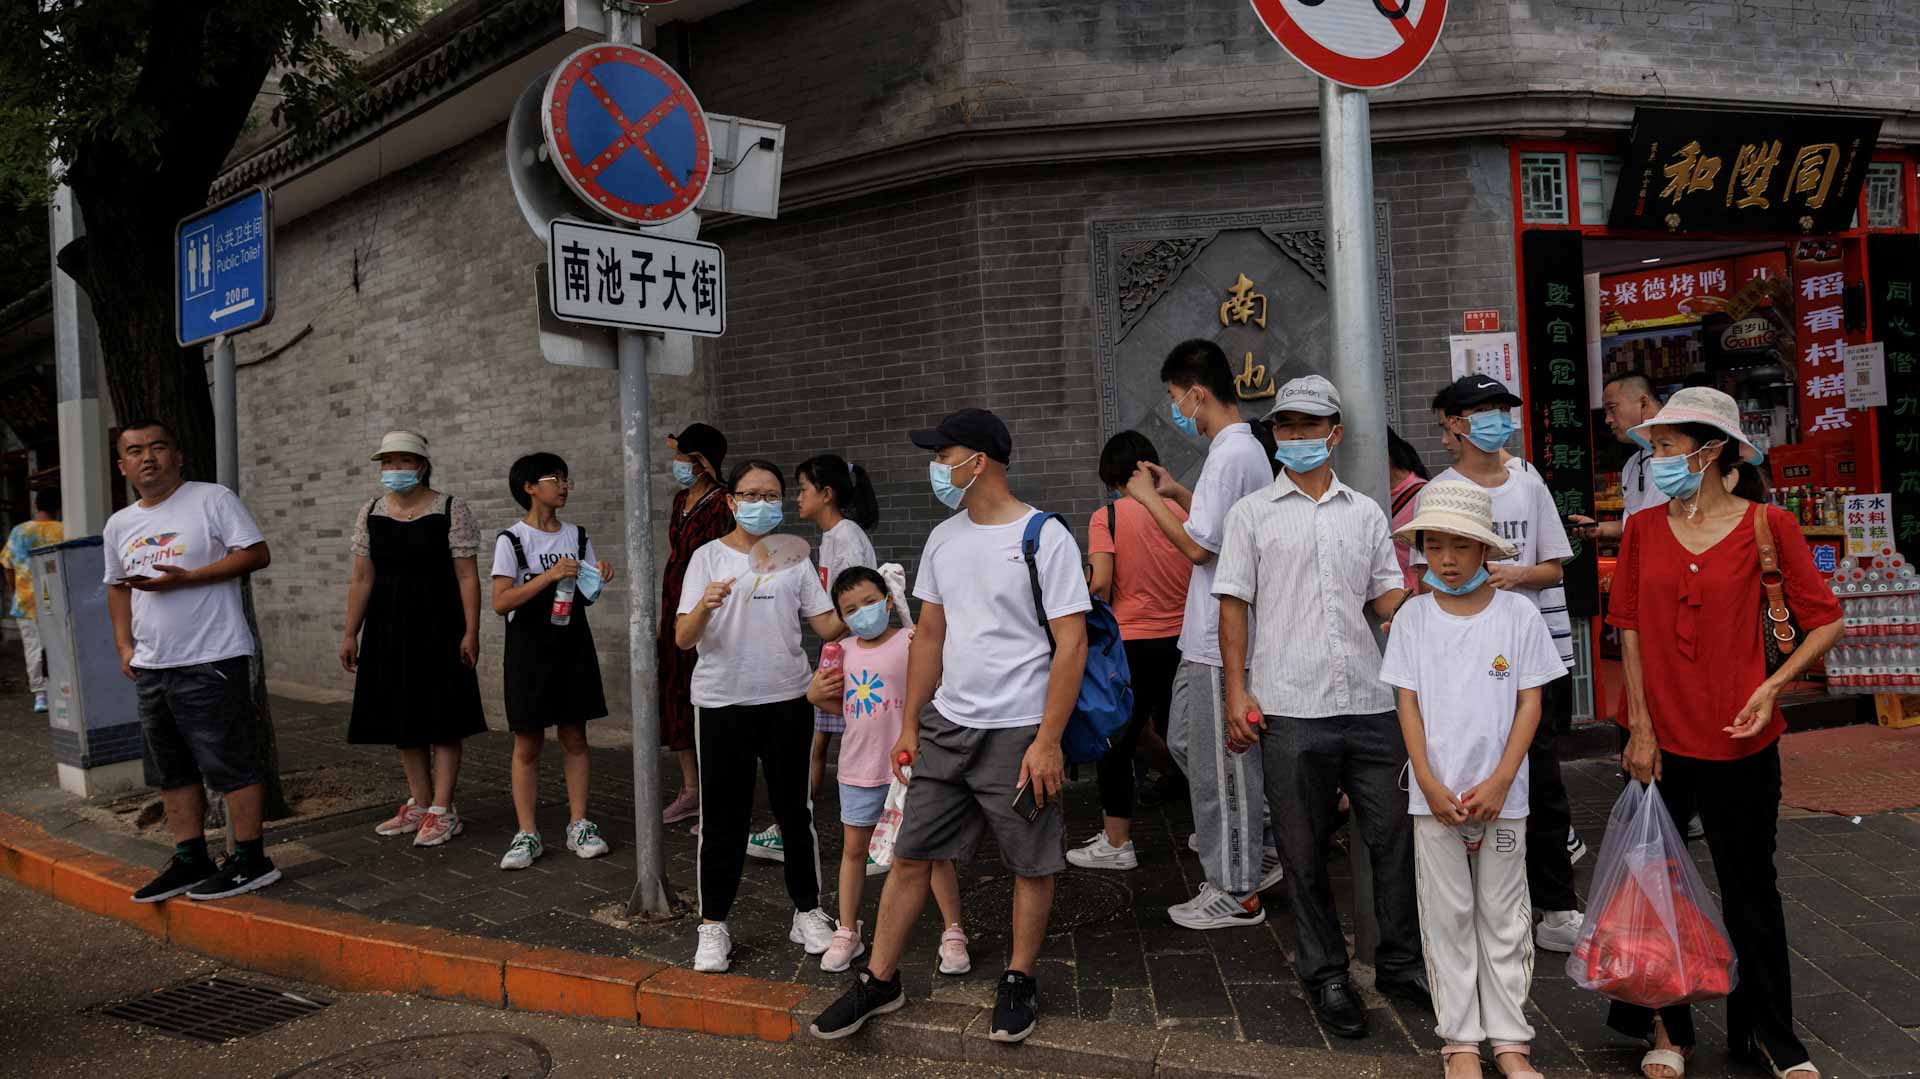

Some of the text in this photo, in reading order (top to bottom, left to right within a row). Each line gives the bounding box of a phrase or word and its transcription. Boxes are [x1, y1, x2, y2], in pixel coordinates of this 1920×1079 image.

[215, 216, 263, 253] 公共卫生间
[216, 242, 261, 274] Public Toilet
[561, 240, 717, 317] 南池子大街
[224, 287, 240, 306] 200
[1480, 319, 1485, 329] 1
[1801, 271, 1853, 433] 稻香村糕点
[1848, 511, 1887, 525] 饮料
[1849, 526, 1889, 540] 雪糕
[1813, 545, 1837, 572] 德
